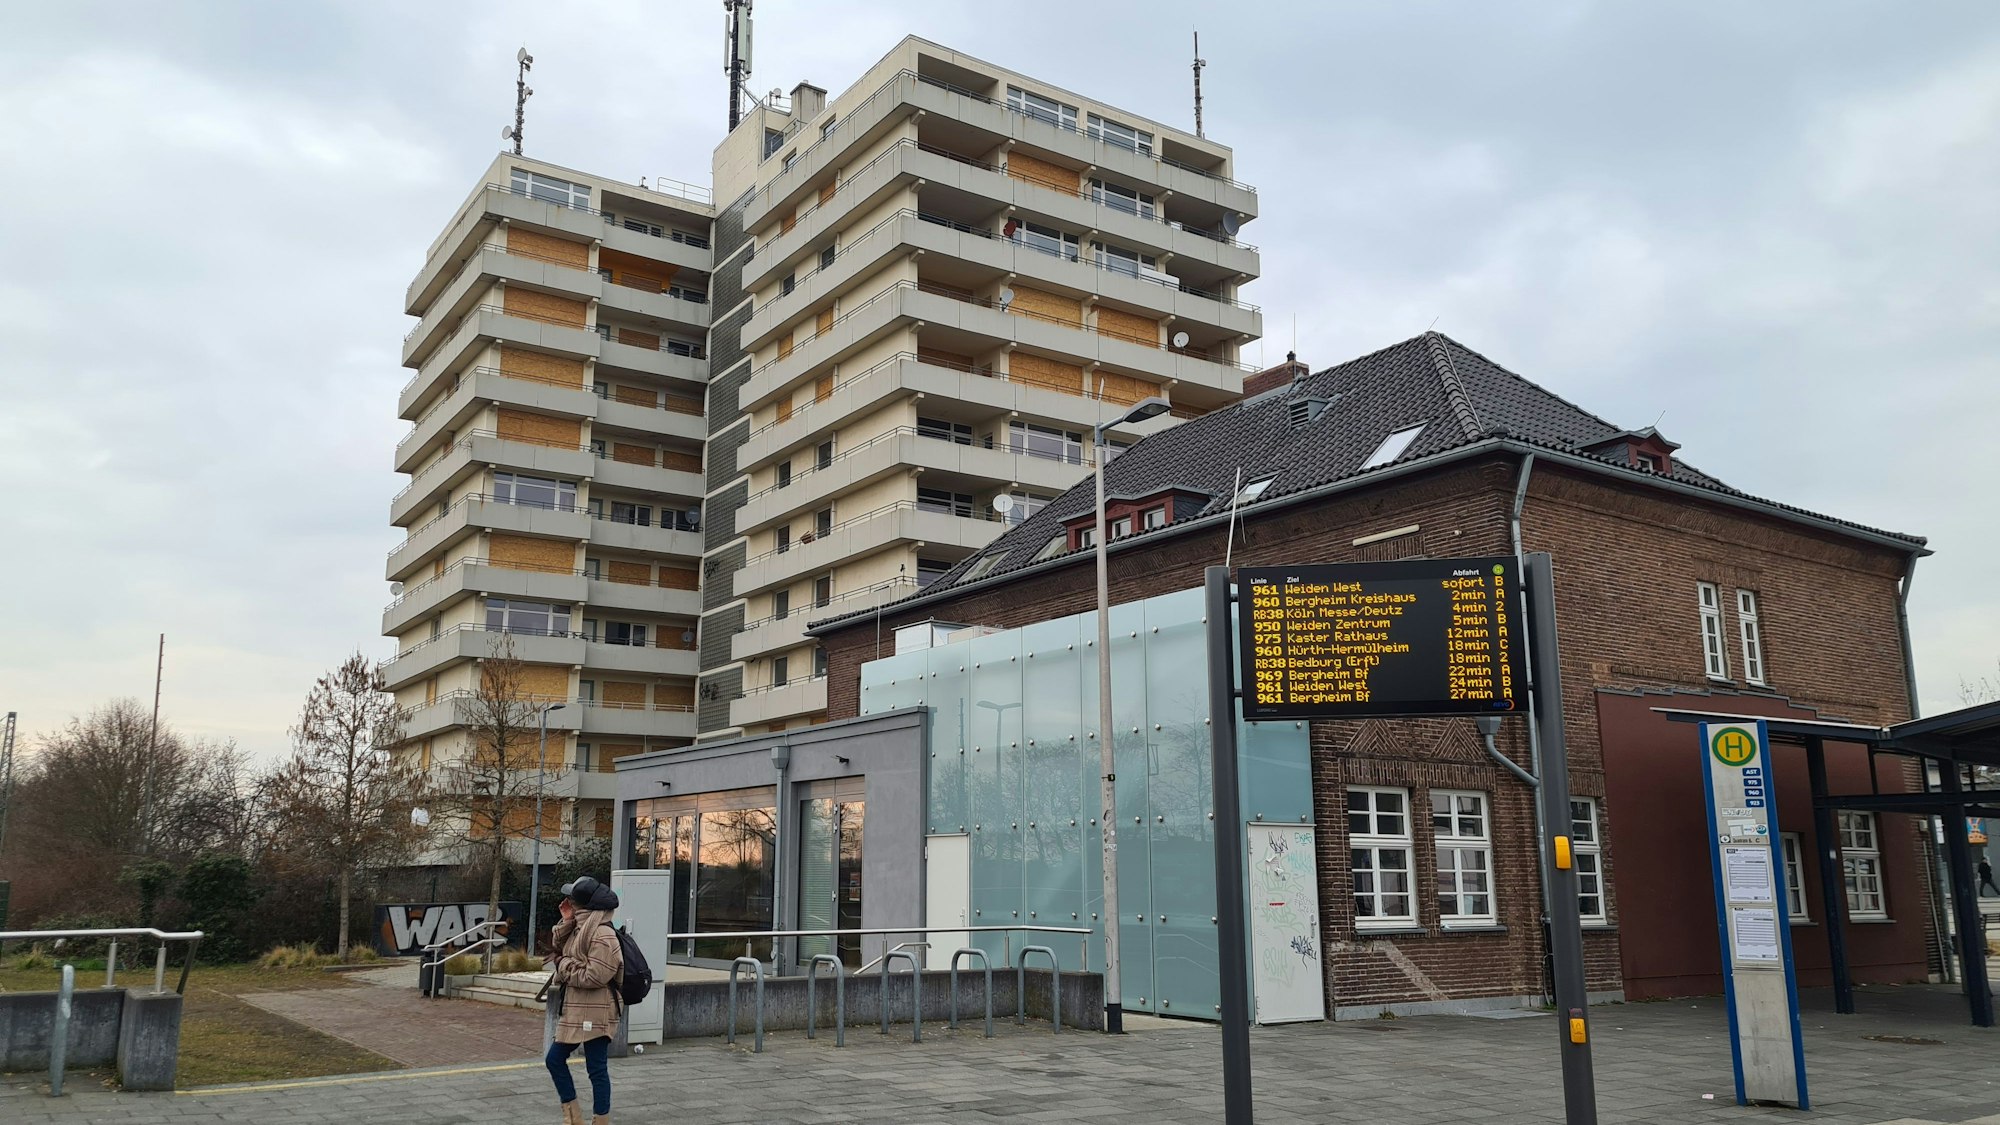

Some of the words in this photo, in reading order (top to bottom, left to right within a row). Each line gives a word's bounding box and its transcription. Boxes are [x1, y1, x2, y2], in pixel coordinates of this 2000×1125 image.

[1253, 585, 1279, 595] 961
[1285, 584, 1328, 594] Weiden
[1334, 582, 1362, 592] West
[1442, 577, 1484, 588] sofort
[1495, 576, 1503, 586] B
[1253, 598, 1279, 607] 960
[1286, 595, 1346, 608] Bergheim
[1351, 593, 1416, 604] Kreishaus
[1452, 590, 1485, 600] 2min
[1496, 589, 1504, 598] A
[1254, 609, 1284, 619] RB38
[1287, 608, 1314, 618] Köln
[1320, 606, 1402, 617] Messe/Deutz
[1453, 602, 1486, 612] 4min
[1496, 601, 1504, 611] 2
[1254, 622, 1280, 632] 950
[1287, 621, 1330, 630] Weiden
[1336, 619, 1390, 629] Zentrum
[1454, 615, 1487, 625] 5min
[1498, 614, 1506, 623] B
[1255, 634, 1281, 644] 975
[1288, 633, 1329, 643] Kaster
[1335, 631, 1388, 641] Rathaus
[1448, 628, 1488, 638] 12min
[1499, 626, 1507, 636] A
[1255, 646, 1282, 656] 960
[1288, 643, 1408, 655] Hürth-Hermülheim
[1449, 640, 1489, 650] 18min
[1500, 639, 1508, 649] C
[1256, 658, 1286, 668] RB38
[1289, 657, 1341, 668] Bedburg
[1347, 656, 1379, 667] (Erft)
[1450, 653, 1490, 663] 18min
[1500, 652, 1508, 662] 2
[1256, 671, 1283, 681] 969
[1289, 669, 1350, 680] Bergheim
[1355, 668, 1369, 679] Bf
[1449, 666, 1491, 676] 22min
[1502, 665, 1510, 674] A
[1257, 682, 1283, 692] 961
[1290, 681, 1333, 691] Weiden
[1339, 680, 1367, 690] West
[1450, 677, 1492, 687] 24min
[1503, 676, 1511, 686] B
[1257, 693, 1283, 703] 961
[1290, 692, 1351, 703] Bergheim
[1356, 691, 1370, 702] Bf
[1451, 689, 1492, 699] 27min
[1504, 688, 1512, 698] A
[1725, 736, 1743, 758] H
[388, 904, 508, 950] WAR
